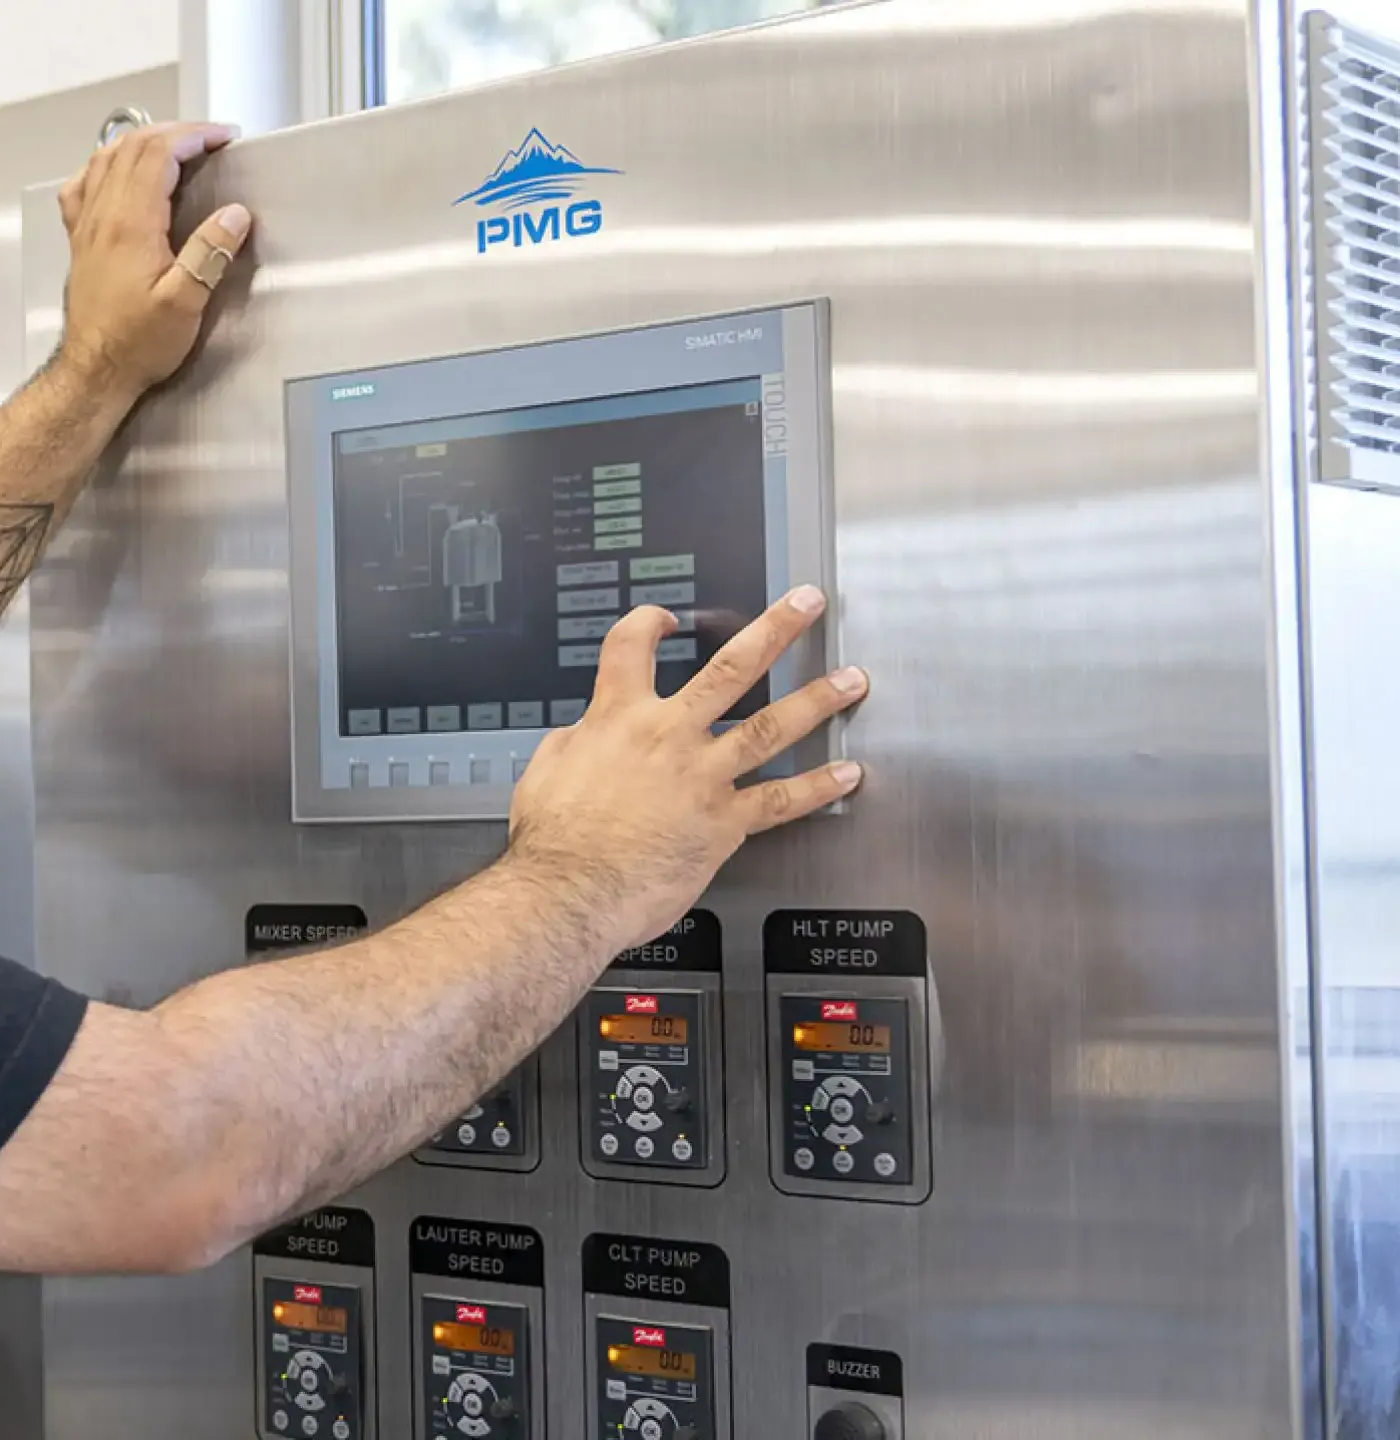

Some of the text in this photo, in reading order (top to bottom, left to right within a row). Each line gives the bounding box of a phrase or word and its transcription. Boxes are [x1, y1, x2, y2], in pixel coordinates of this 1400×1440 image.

[477, 200, 602, 253] PMG
[764, 377, 787, 455] TOUCH
[255, 925, 301, 940] MIXER
[793, 920, 894, 937] HLT PUMP
[810, 948, 878, 967] SPEED
[287, 1236, 339, 1256] SPEED
[416, 1225, 535, 1250] LAUTER PUMP
[448, 1253, 504, 1274] SPEED
[608, 1243, 701, 1268] CLT PUMP
[625, 1273, 686, 1295] SPEED
[828, 1359, 880, 1379] BUZZER
